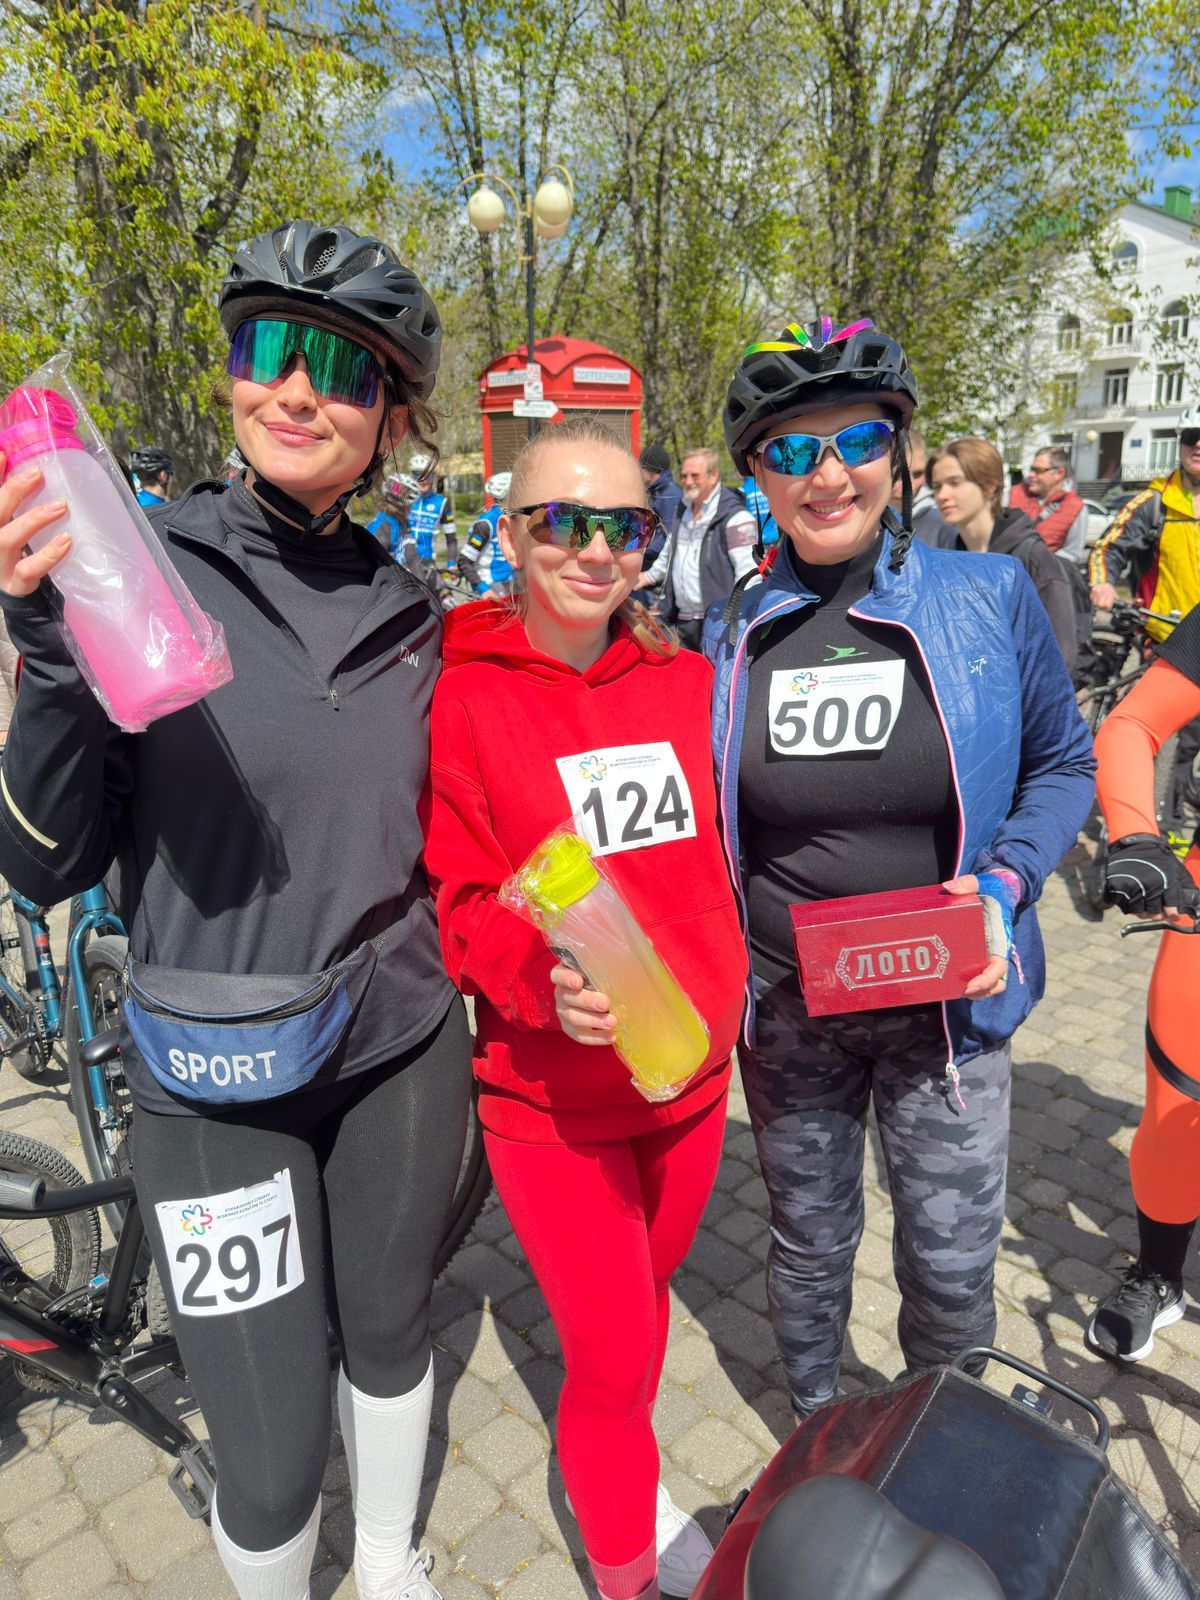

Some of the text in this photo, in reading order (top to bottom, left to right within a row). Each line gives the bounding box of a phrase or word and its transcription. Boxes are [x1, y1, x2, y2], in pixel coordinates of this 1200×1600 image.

[490, 372, 528, 385] COFFEEPHO
[576, 370, 629, 382] COFFEEPHONE
[772, 694, 892, 748] 500
[582, 775, 689, 848] 124
[855, 946, 931, 979] ЛОТО
[168, 1048, 277, 1087] SPORT
[176, 1213, 291, 1307] 297
